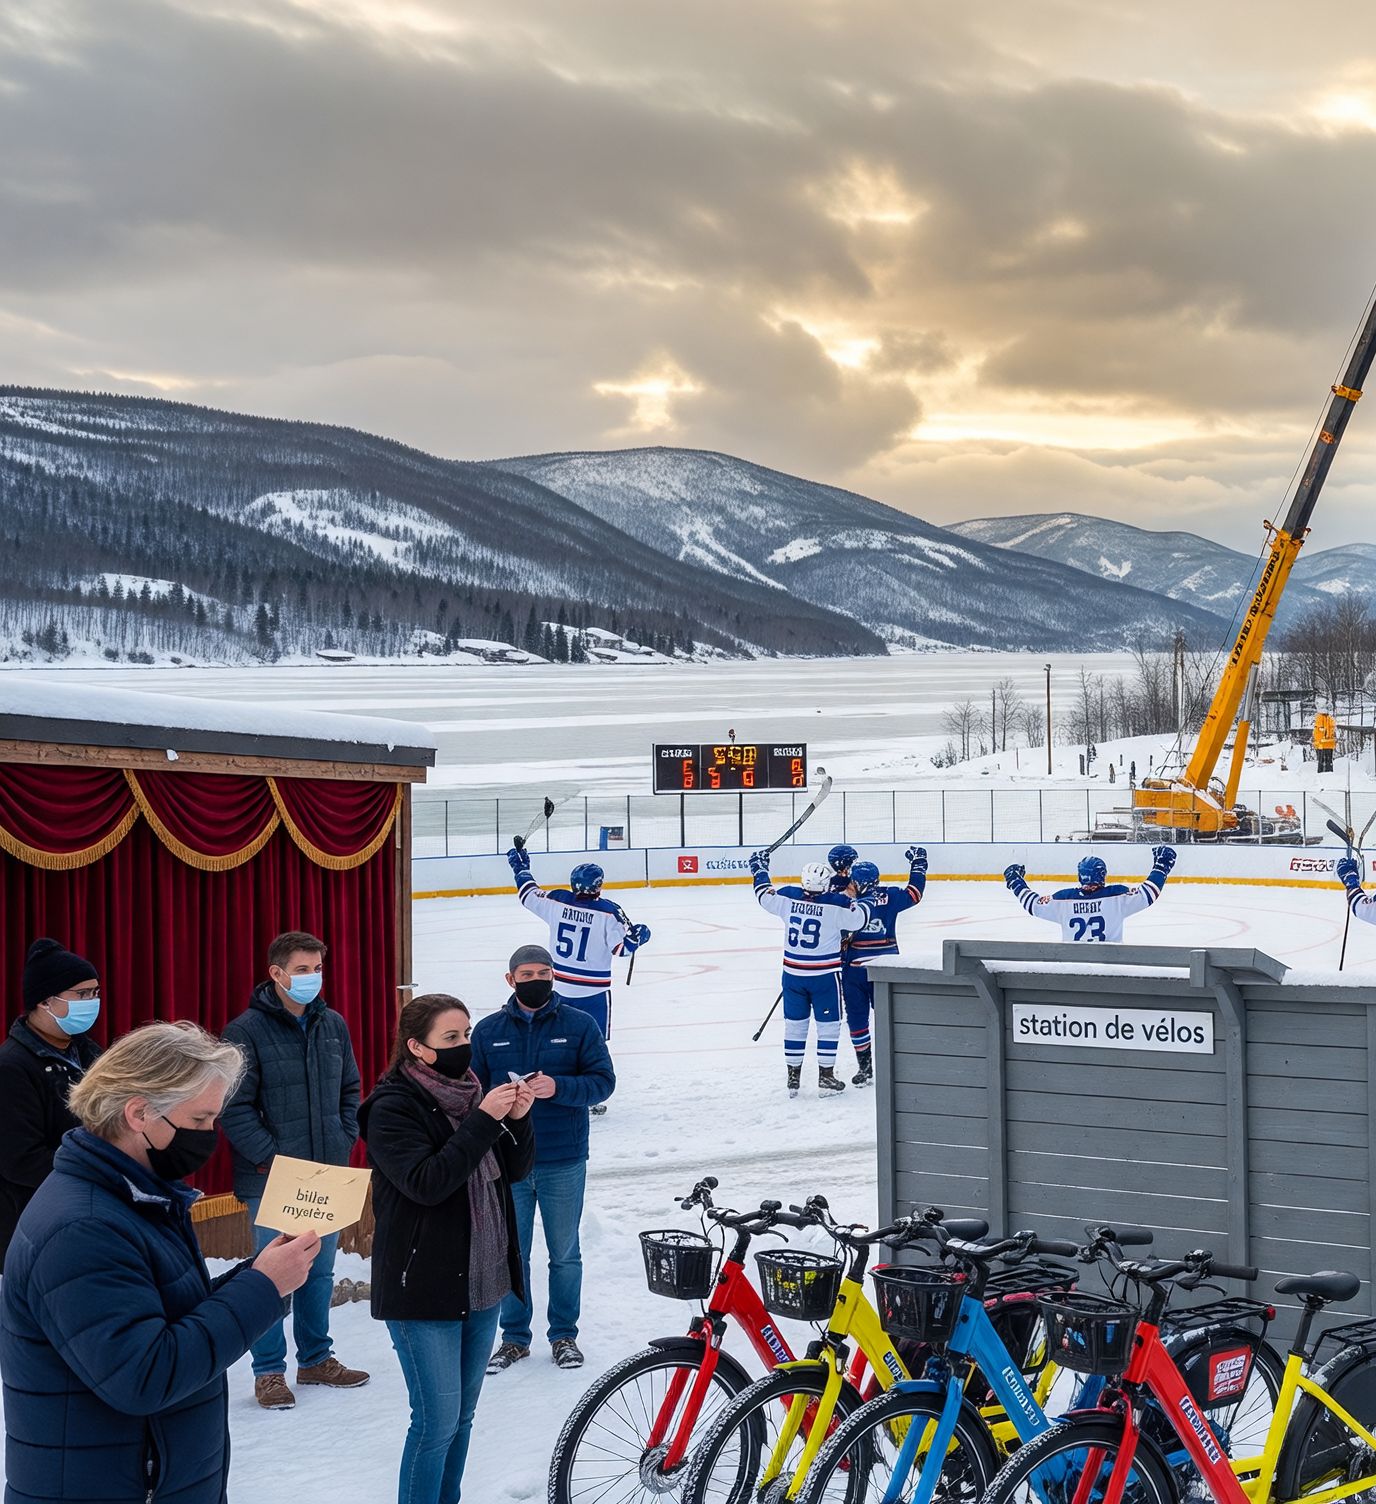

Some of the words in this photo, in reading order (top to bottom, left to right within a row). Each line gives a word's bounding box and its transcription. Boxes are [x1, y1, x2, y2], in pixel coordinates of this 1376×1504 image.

[555, 921, 591, 962] 51
[1069, 915, 1106, 942] 23
[1019, 1013, 1097, 1039] station
[1105, 1014, 1135, 1040] de
[1142, 1017, 1205, 1044] vélos
[296, 1188, 330, 1205] billet
